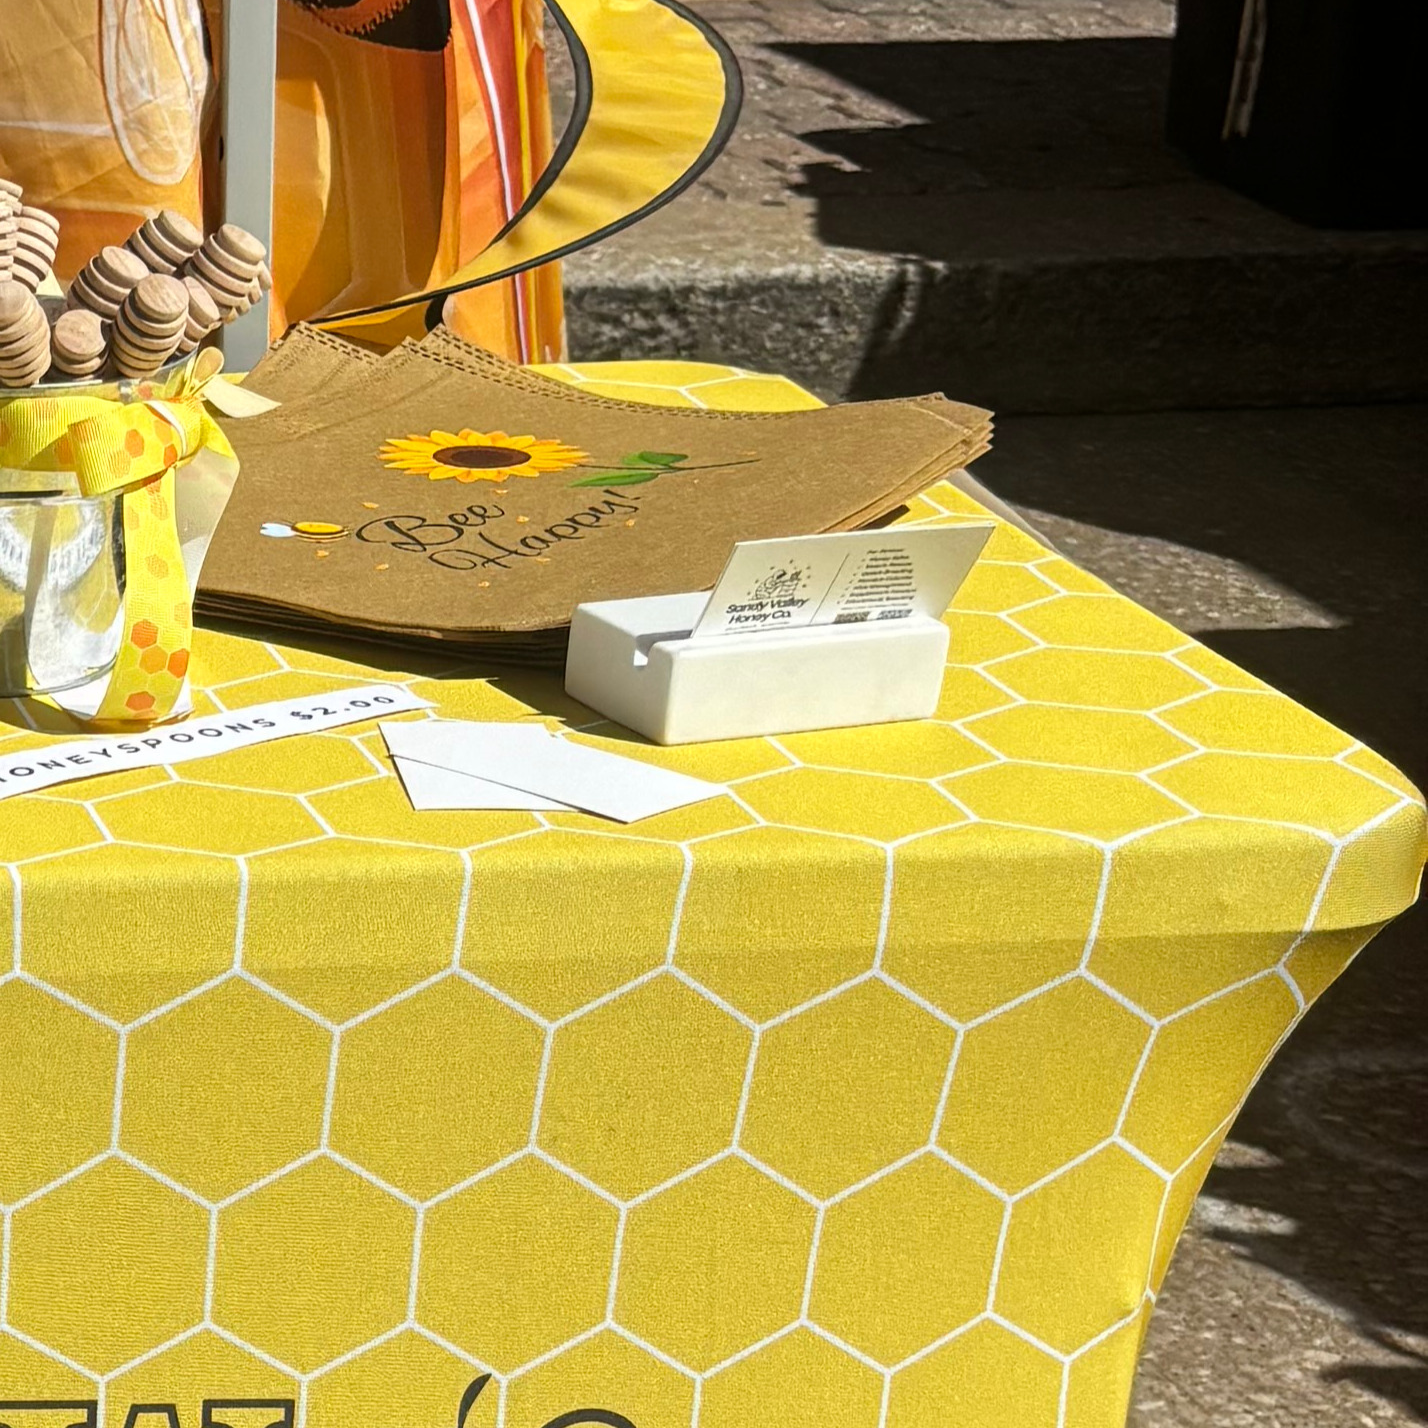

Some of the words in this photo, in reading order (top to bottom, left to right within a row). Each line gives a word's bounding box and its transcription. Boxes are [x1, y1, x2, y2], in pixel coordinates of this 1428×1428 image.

[355, 503, 505, 553] Bee
[427, 488, 642, 570] Happy!
[725, 600, 769, 615] Sandy
[770, 596, 811, 611] Valley
[728, 611, 772, 625] Honey
[290, 695, 396, 722] $2.00
